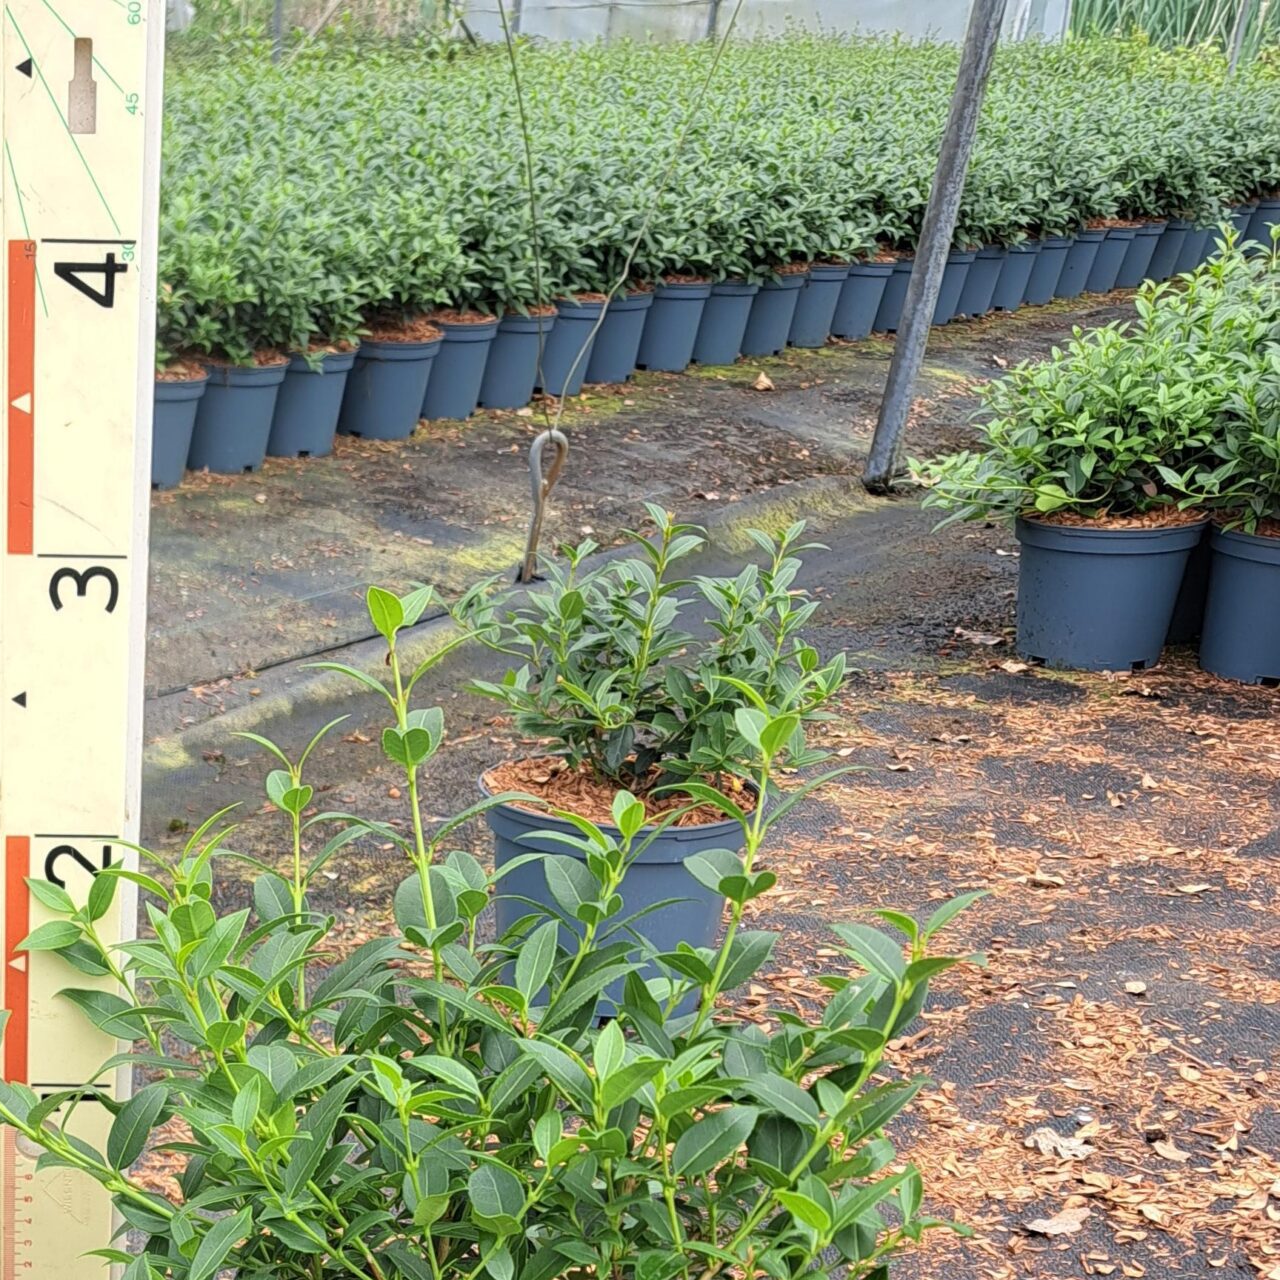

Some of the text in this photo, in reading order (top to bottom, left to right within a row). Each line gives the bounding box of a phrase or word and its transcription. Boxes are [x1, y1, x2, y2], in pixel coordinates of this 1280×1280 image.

[125, 93, 139, 115] 45
[24, 241, 37, 259] 15
[54, 252, 128, 308] 4
[49, 566, 119, 613] 3
[45, 845, 111, 889] 2
